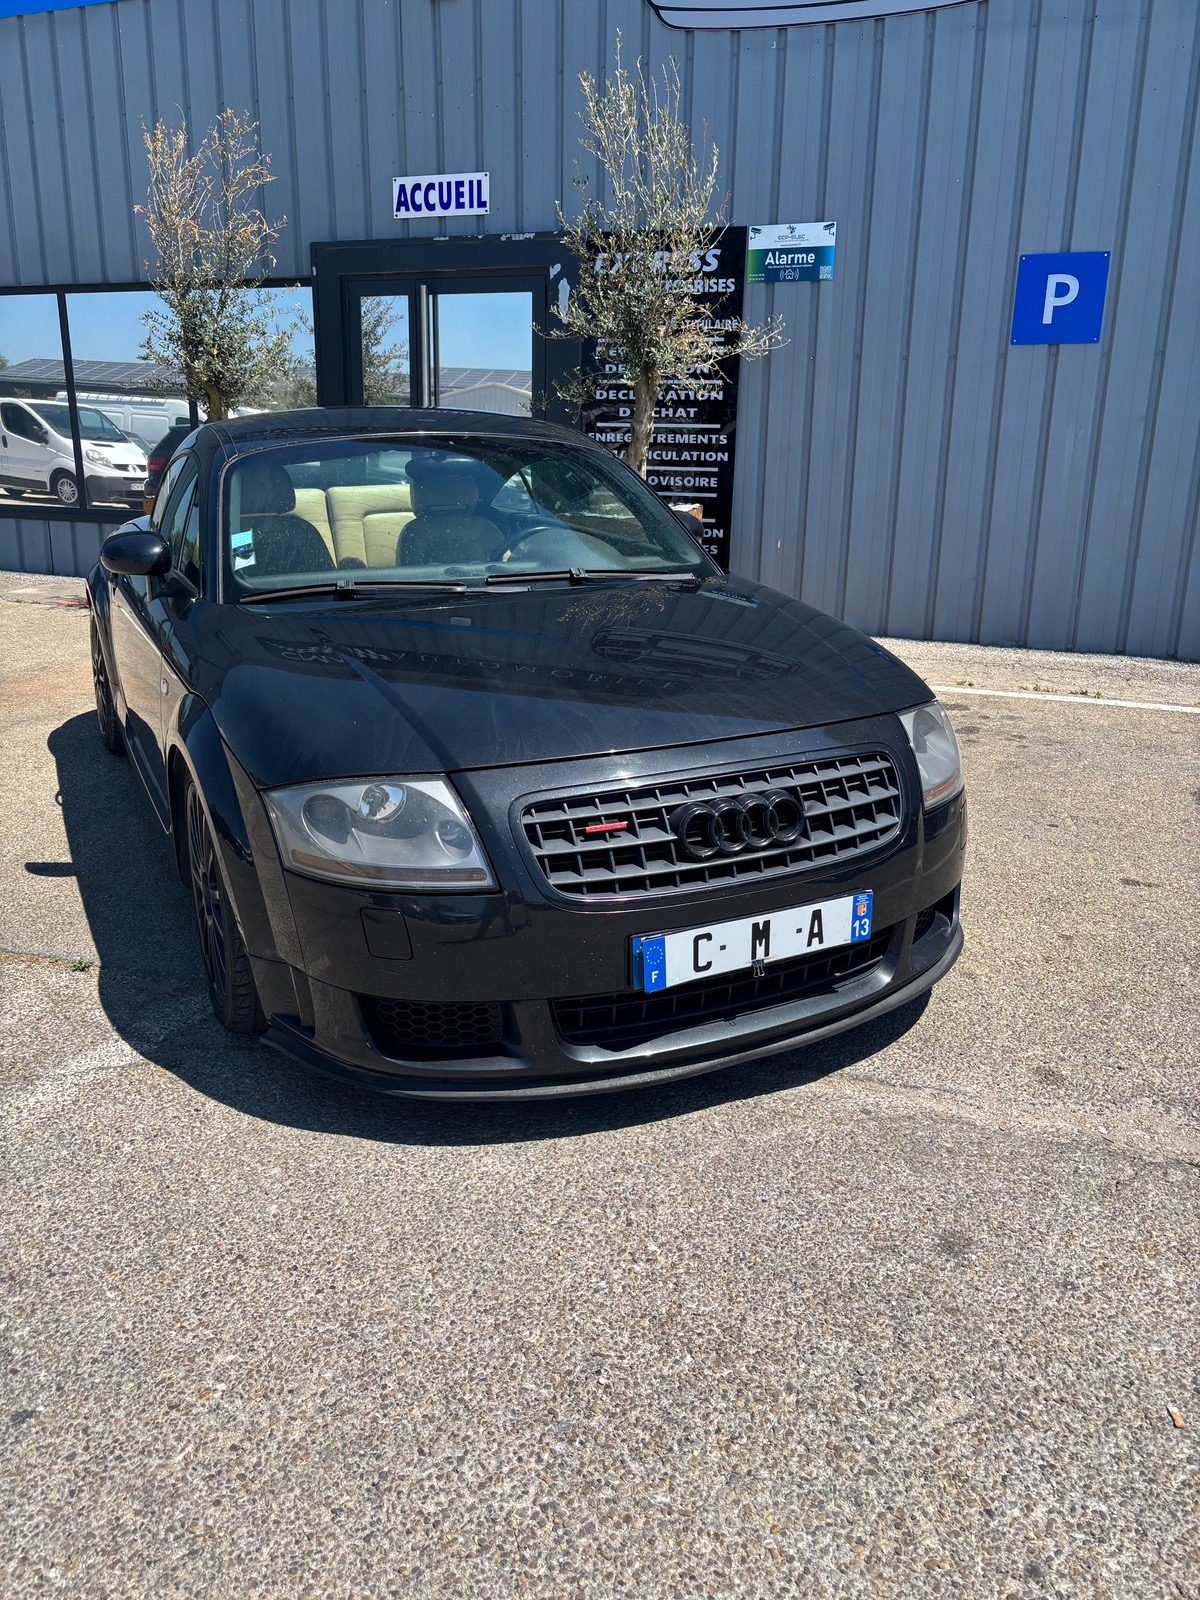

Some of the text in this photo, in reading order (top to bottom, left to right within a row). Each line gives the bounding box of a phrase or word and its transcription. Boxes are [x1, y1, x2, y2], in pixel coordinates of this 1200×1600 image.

[395, 179, 487, 212] ACCUEIL
[765, 251, 816, 266] Alarme
[1042, 273, 1080, 325] P
[595, 390, 724, 401] DECLRATION
[618, 407, 698, 418] D'CHAT
[588, 432, 728, 445] ENREGTREMENTS
[647, 476, 718, 488] OVISOIRE
[852, 918, 870, 937] 13
[651, 970, 659, 984] F
